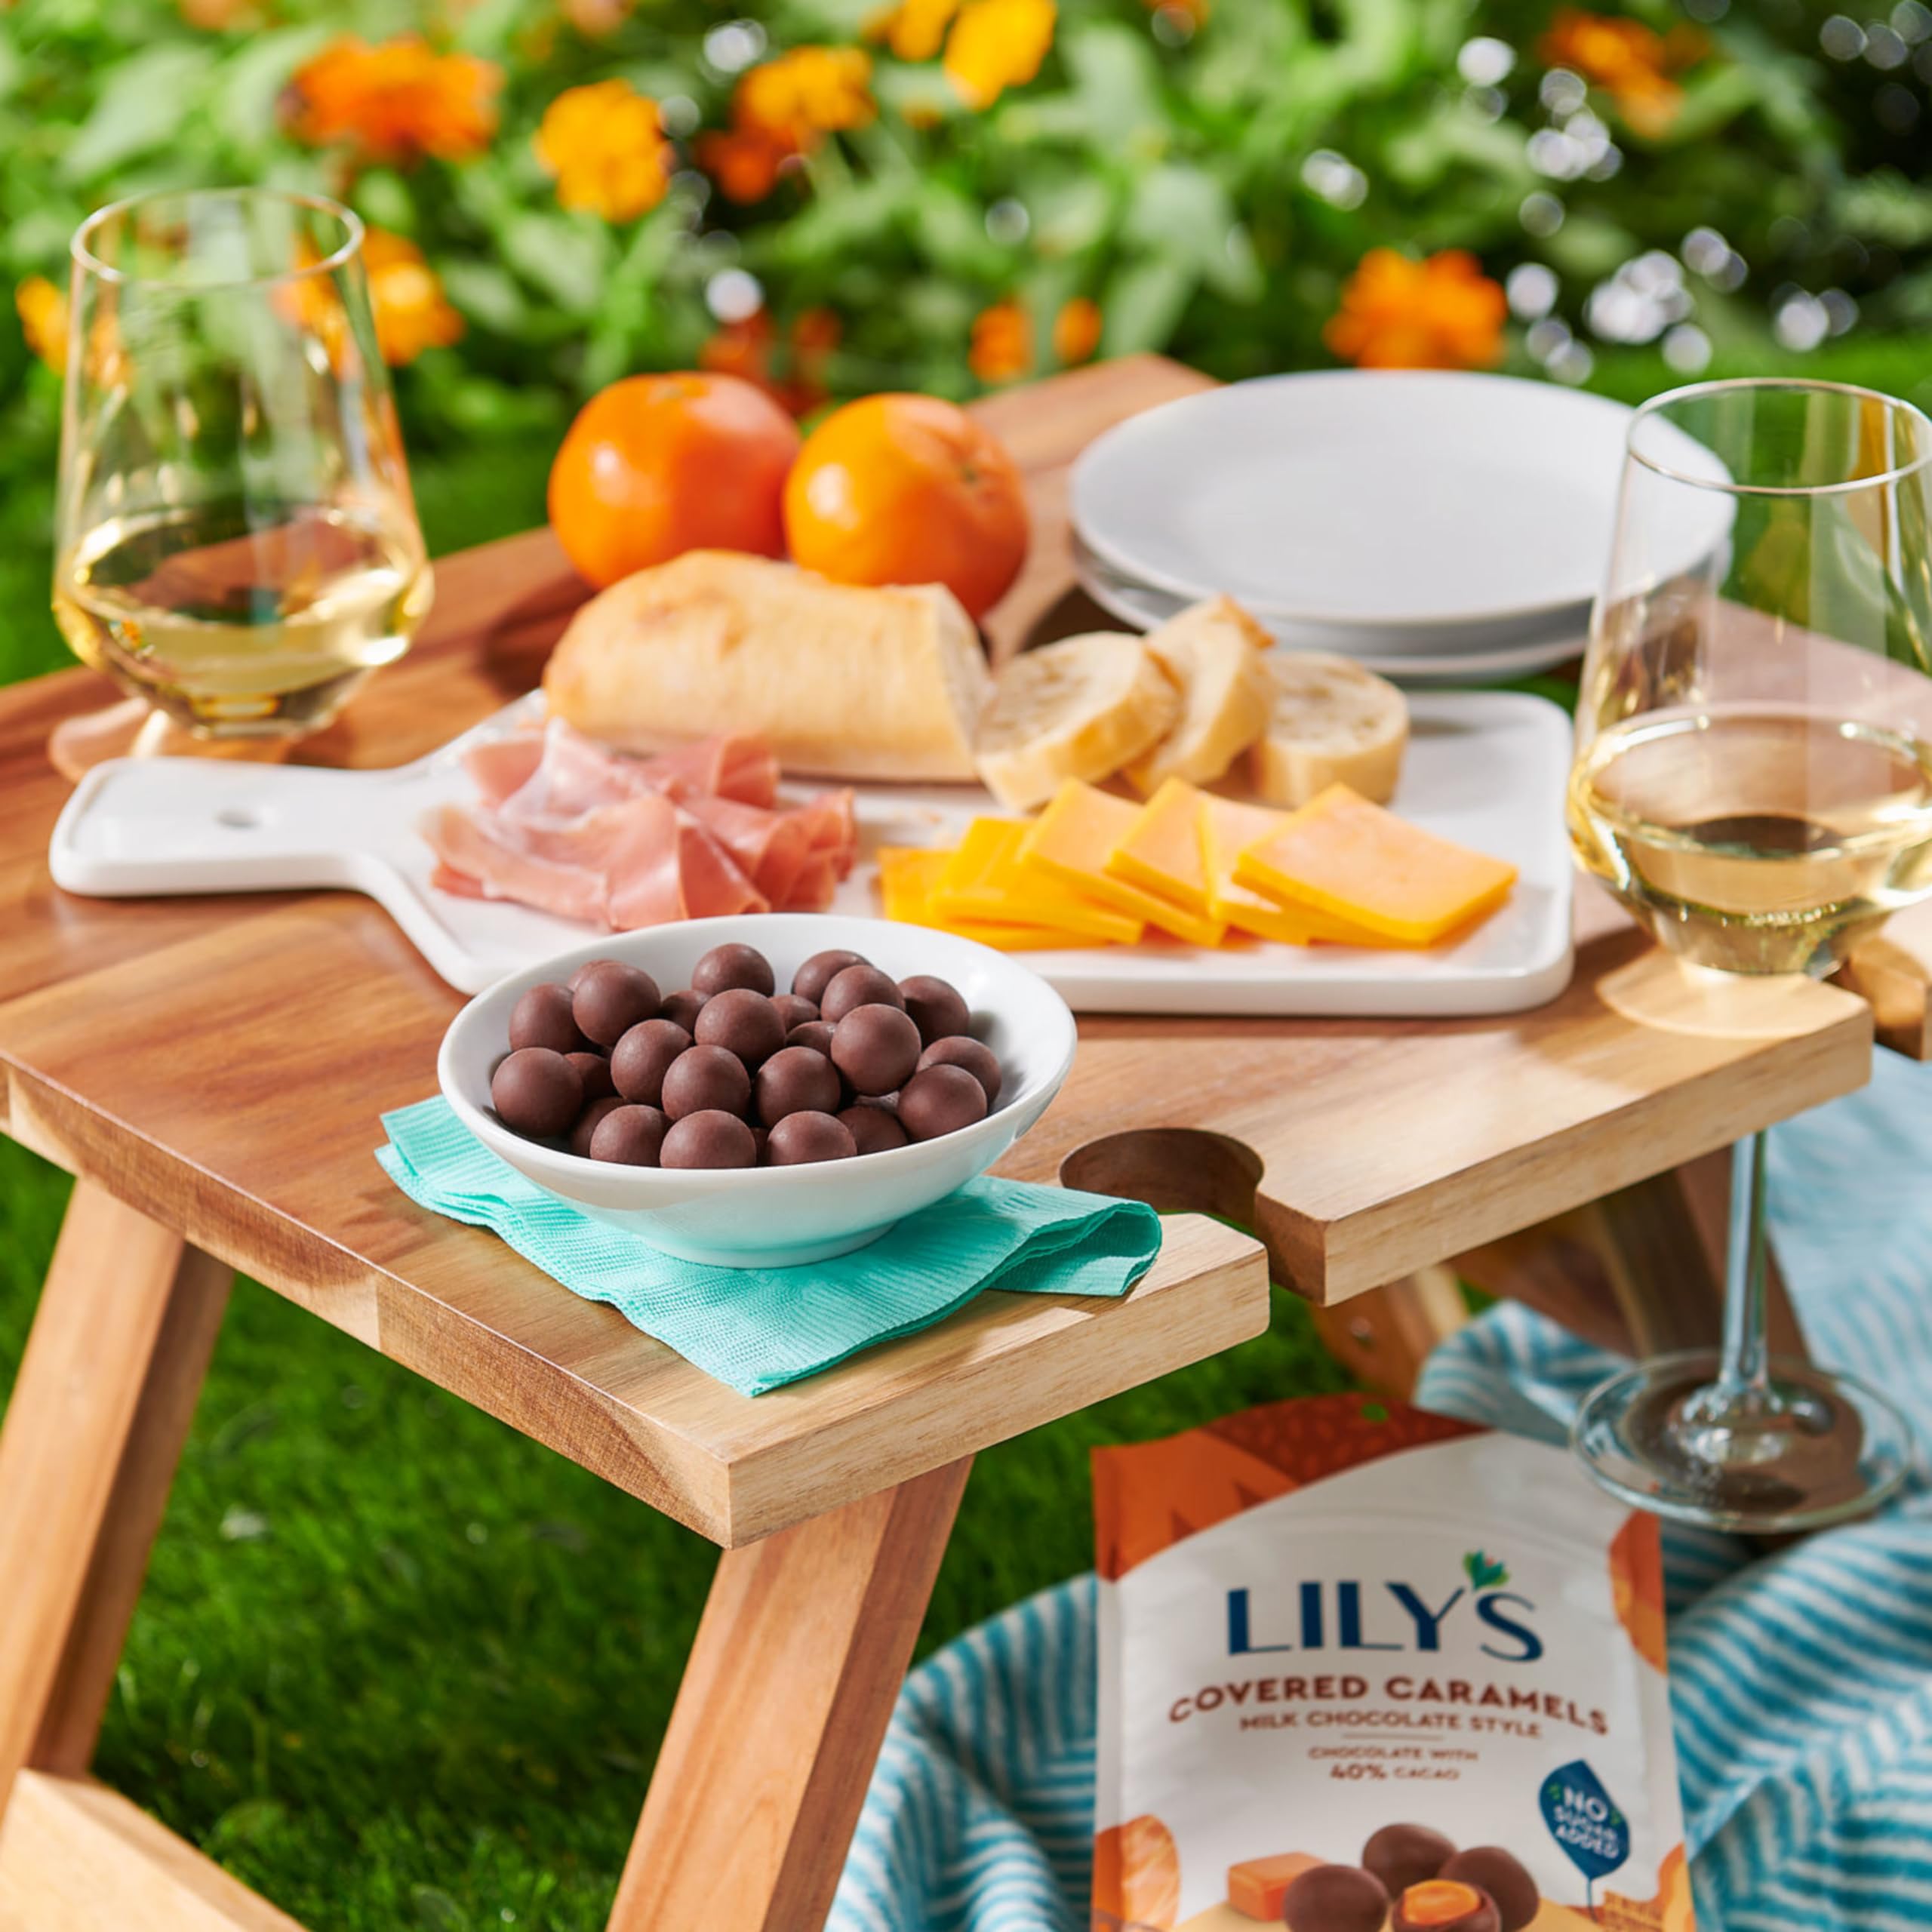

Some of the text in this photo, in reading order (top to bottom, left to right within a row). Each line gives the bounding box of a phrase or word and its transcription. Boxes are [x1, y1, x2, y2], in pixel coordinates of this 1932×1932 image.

[1168, 1675, 1609, 1736] COVERED CARAMELS
[1240, 1710, 1542, 1739] MILK CHOCOLATE STYLE
[1308, 1746, 1479, 1761] CHOCOLATE WITH
[1330, 1763, 1460, 1781] 40% CACAO
[1563, 1786, 1608, 1823] NO
[1555, 1823, 1620, 1859] ADDED
